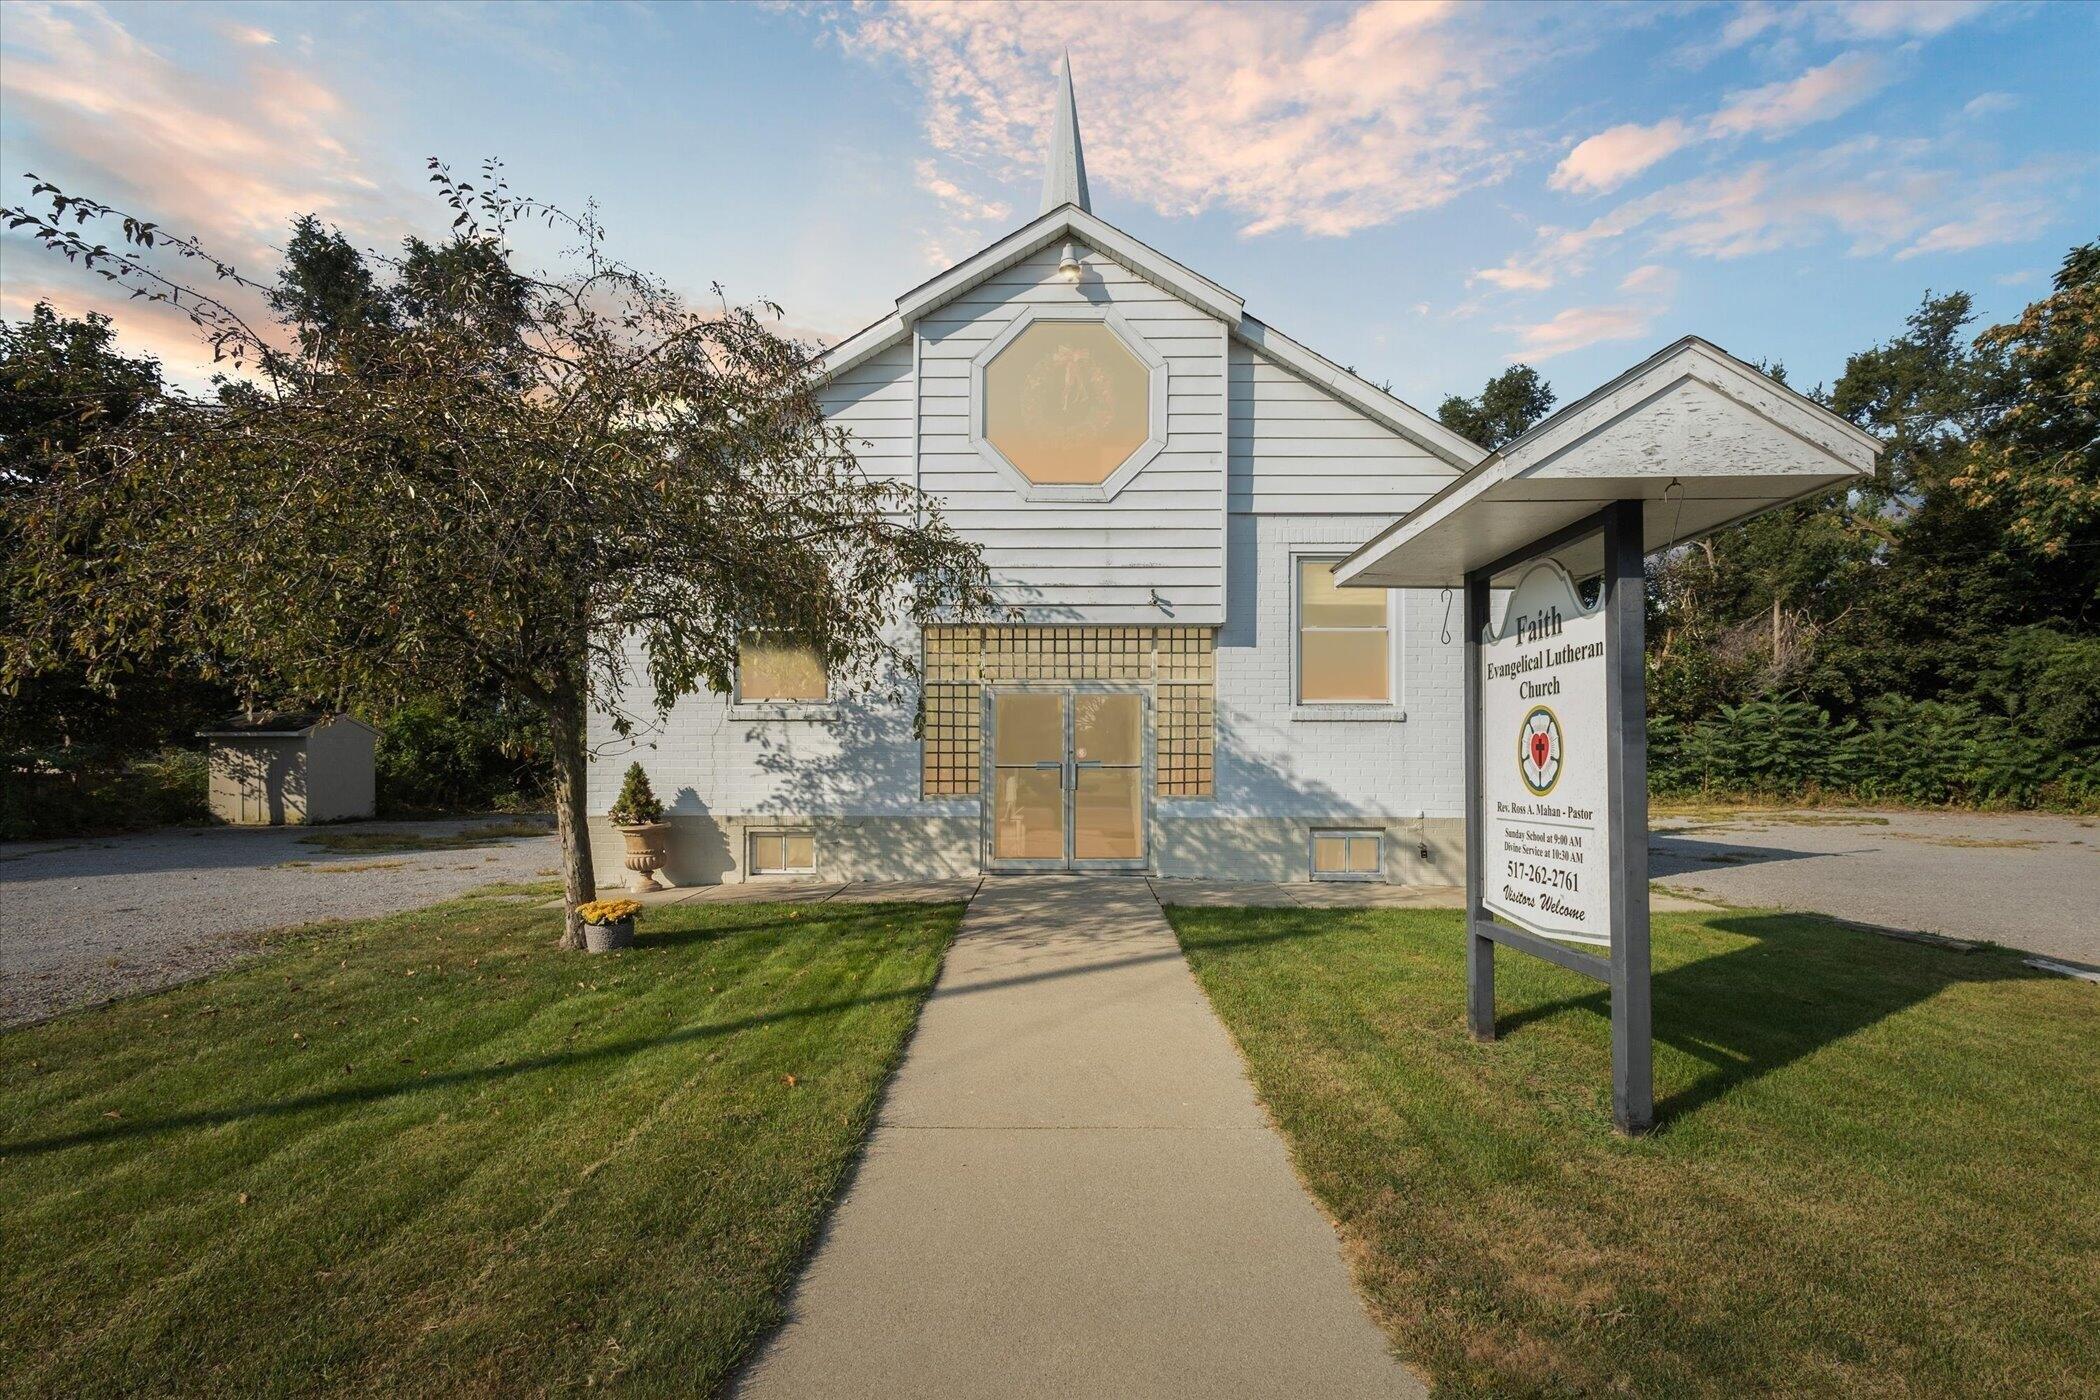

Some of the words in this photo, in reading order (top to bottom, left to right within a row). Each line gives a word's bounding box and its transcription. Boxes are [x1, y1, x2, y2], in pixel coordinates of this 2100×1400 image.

[1516, 606, 1562, 646] Faith
[1487, 651, 1543, 680] Evangelical
[1546, 641, 1604, 667] Lutheran
[1520, 676, 1560, 700] Church
[1497, 802, 1510, 813] Rev.
[1511, 803, 1526, 815] Ross
[1527, 804, 1535, 815] A.
[1536, 804, 1561, 817] Mahan
[1568, 806, 1593, 820] Pastor
[1505, 828, 1525, 841] Sunday
[1526, 830, 1545, 843] School
[1546, 835, 1553, 843] at
[1554, 834, 1568, 846] 9:00
[1569, 836, 1582, 848] AM
[1504, 842, 1521, 853] Divine
[1522, 844, 1543, 857] Service
[1544, 849, 1551, 858] at
[1552, 849, 1569, 861] 10:30
[1570, 852, 1583, 864] AM
[1507, 860, 1579, 892] 517-262-2761
[1503, 884, 1536, 907] Visitors
[1540, 893, 1585, 921] Welcome
